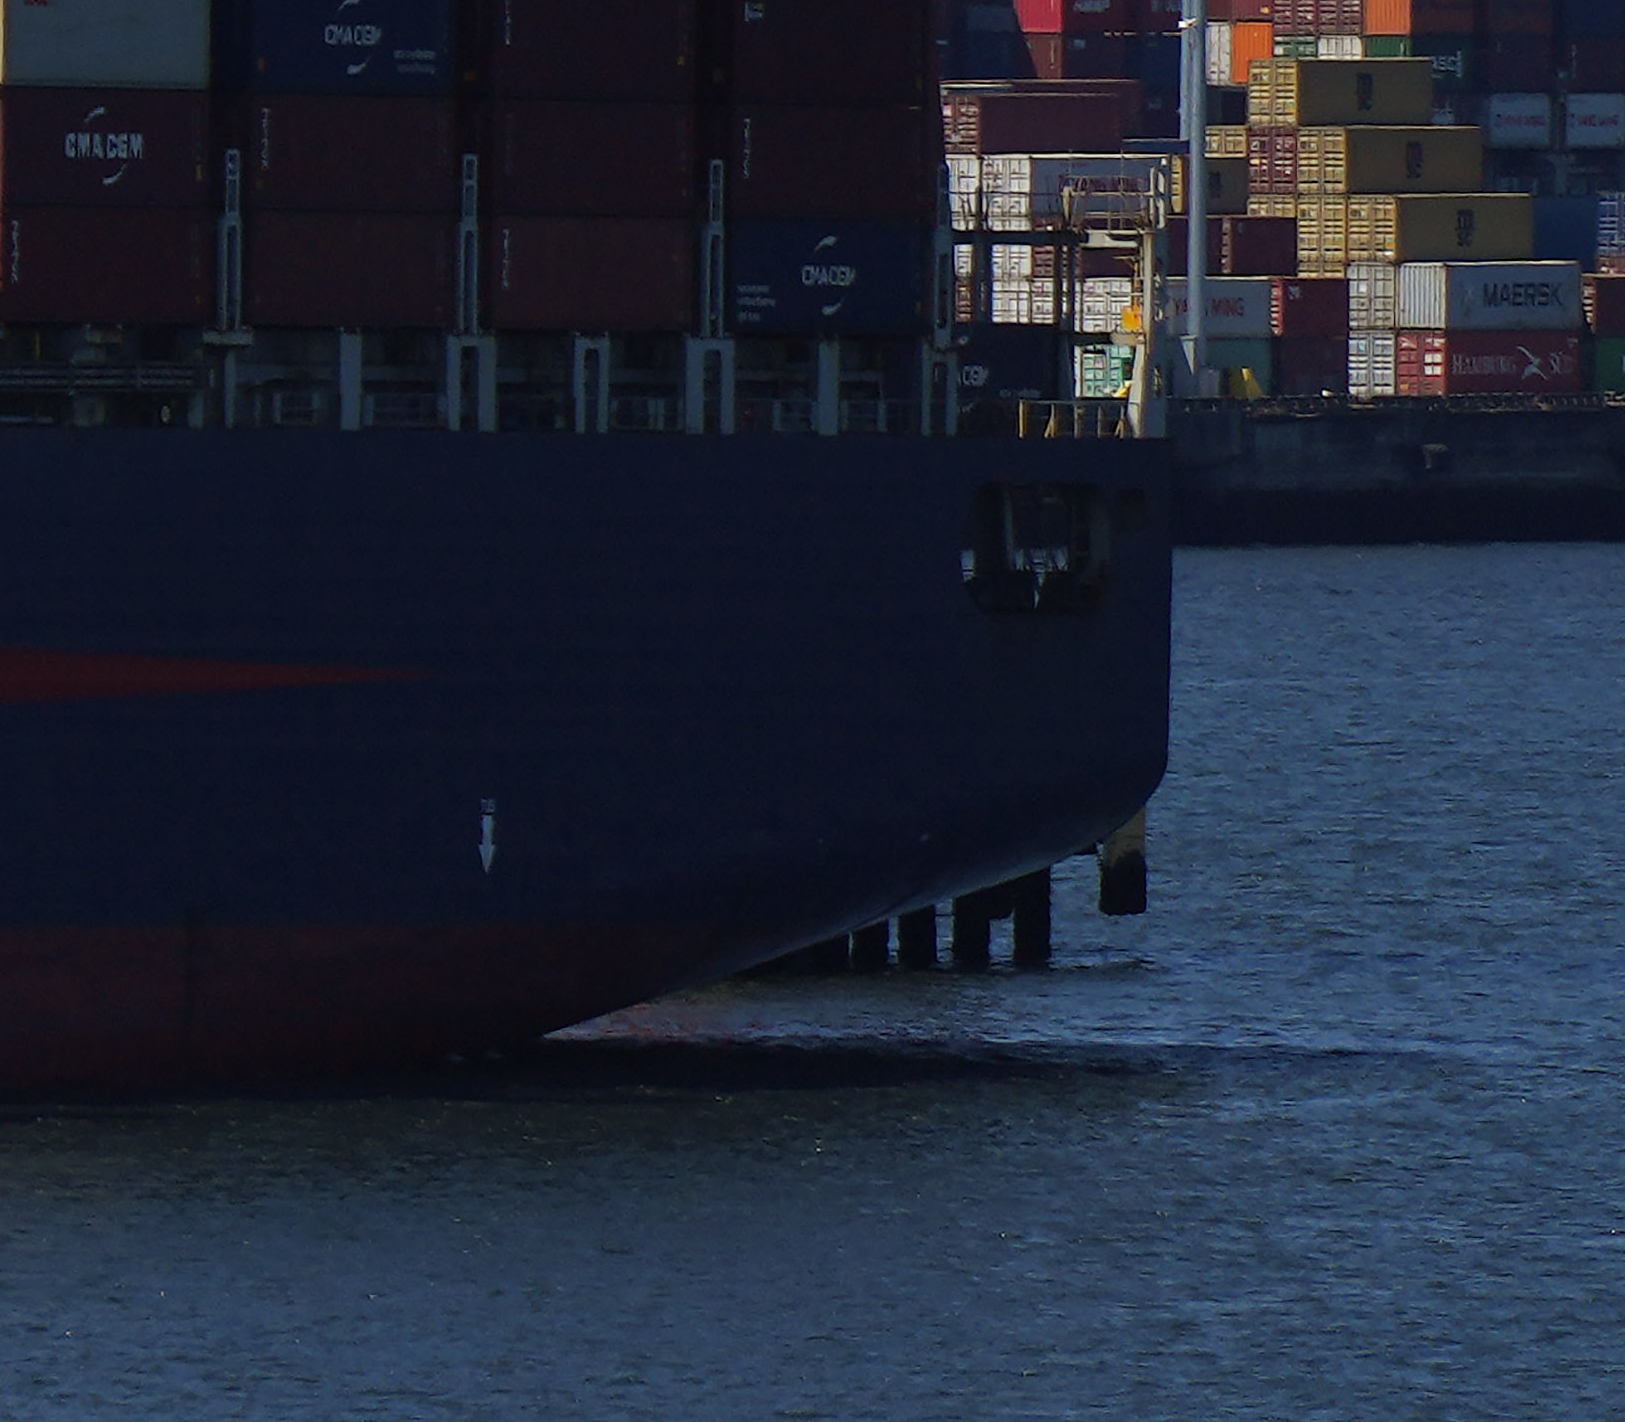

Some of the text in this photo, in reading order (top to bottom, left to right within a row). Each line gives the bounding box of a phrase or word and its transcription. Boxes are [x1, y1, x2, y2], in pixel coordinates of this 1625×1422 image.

[64, 132, 143, 159] CMA CGM
[1483, 281, 1563, 308] MAERSK
